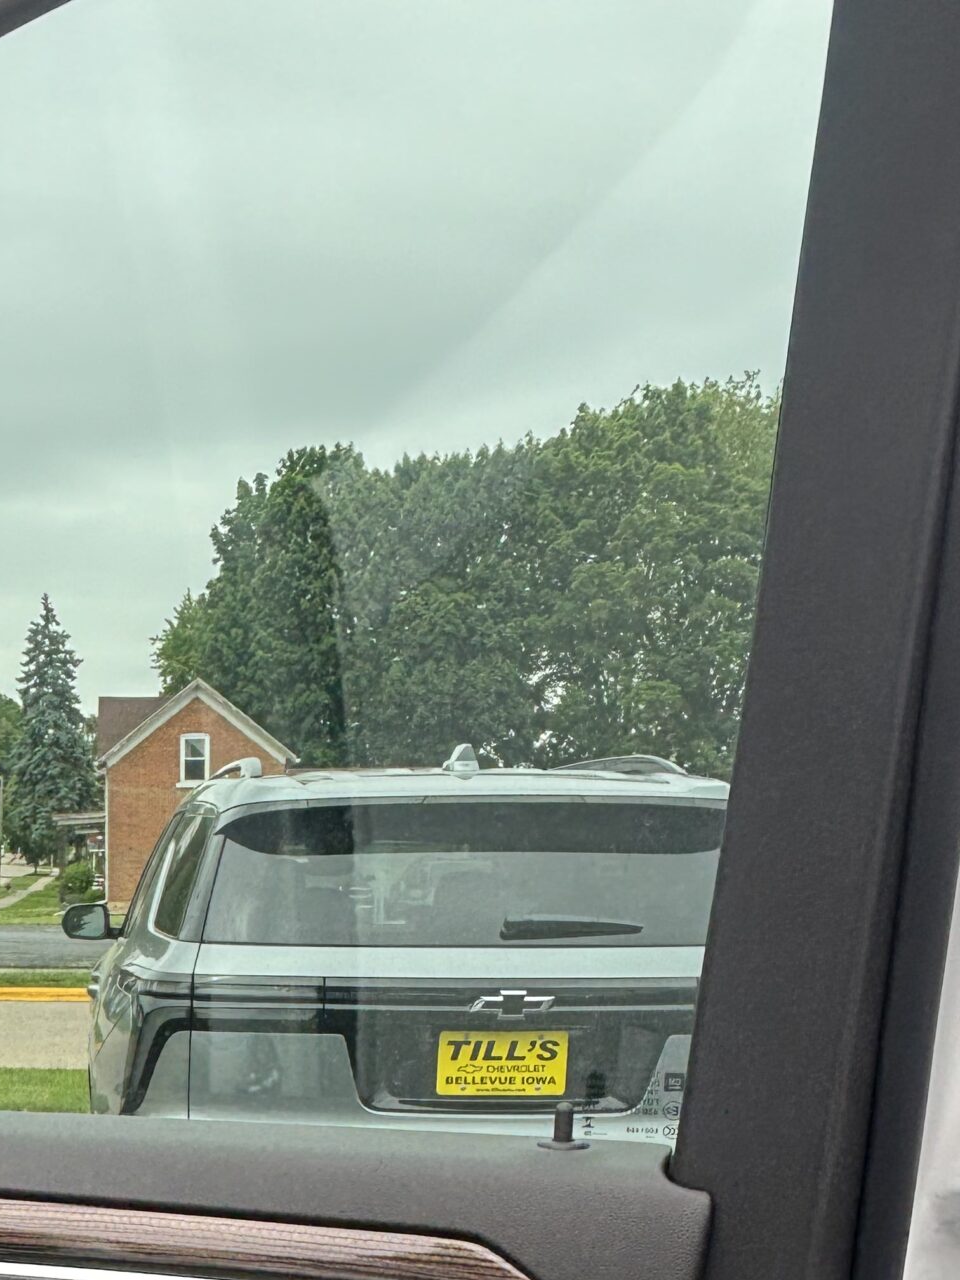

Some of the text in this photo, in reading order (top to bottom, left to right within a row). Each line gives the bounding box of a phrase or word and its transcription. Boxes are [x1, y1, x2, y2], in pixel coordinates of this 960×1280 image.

[446, 1040, 560, 1061] TILL'S
[486, 1064, 546, 1073] CHEVROLET
[445, 1076, 557, 1085] BELLEVUE IOWA
